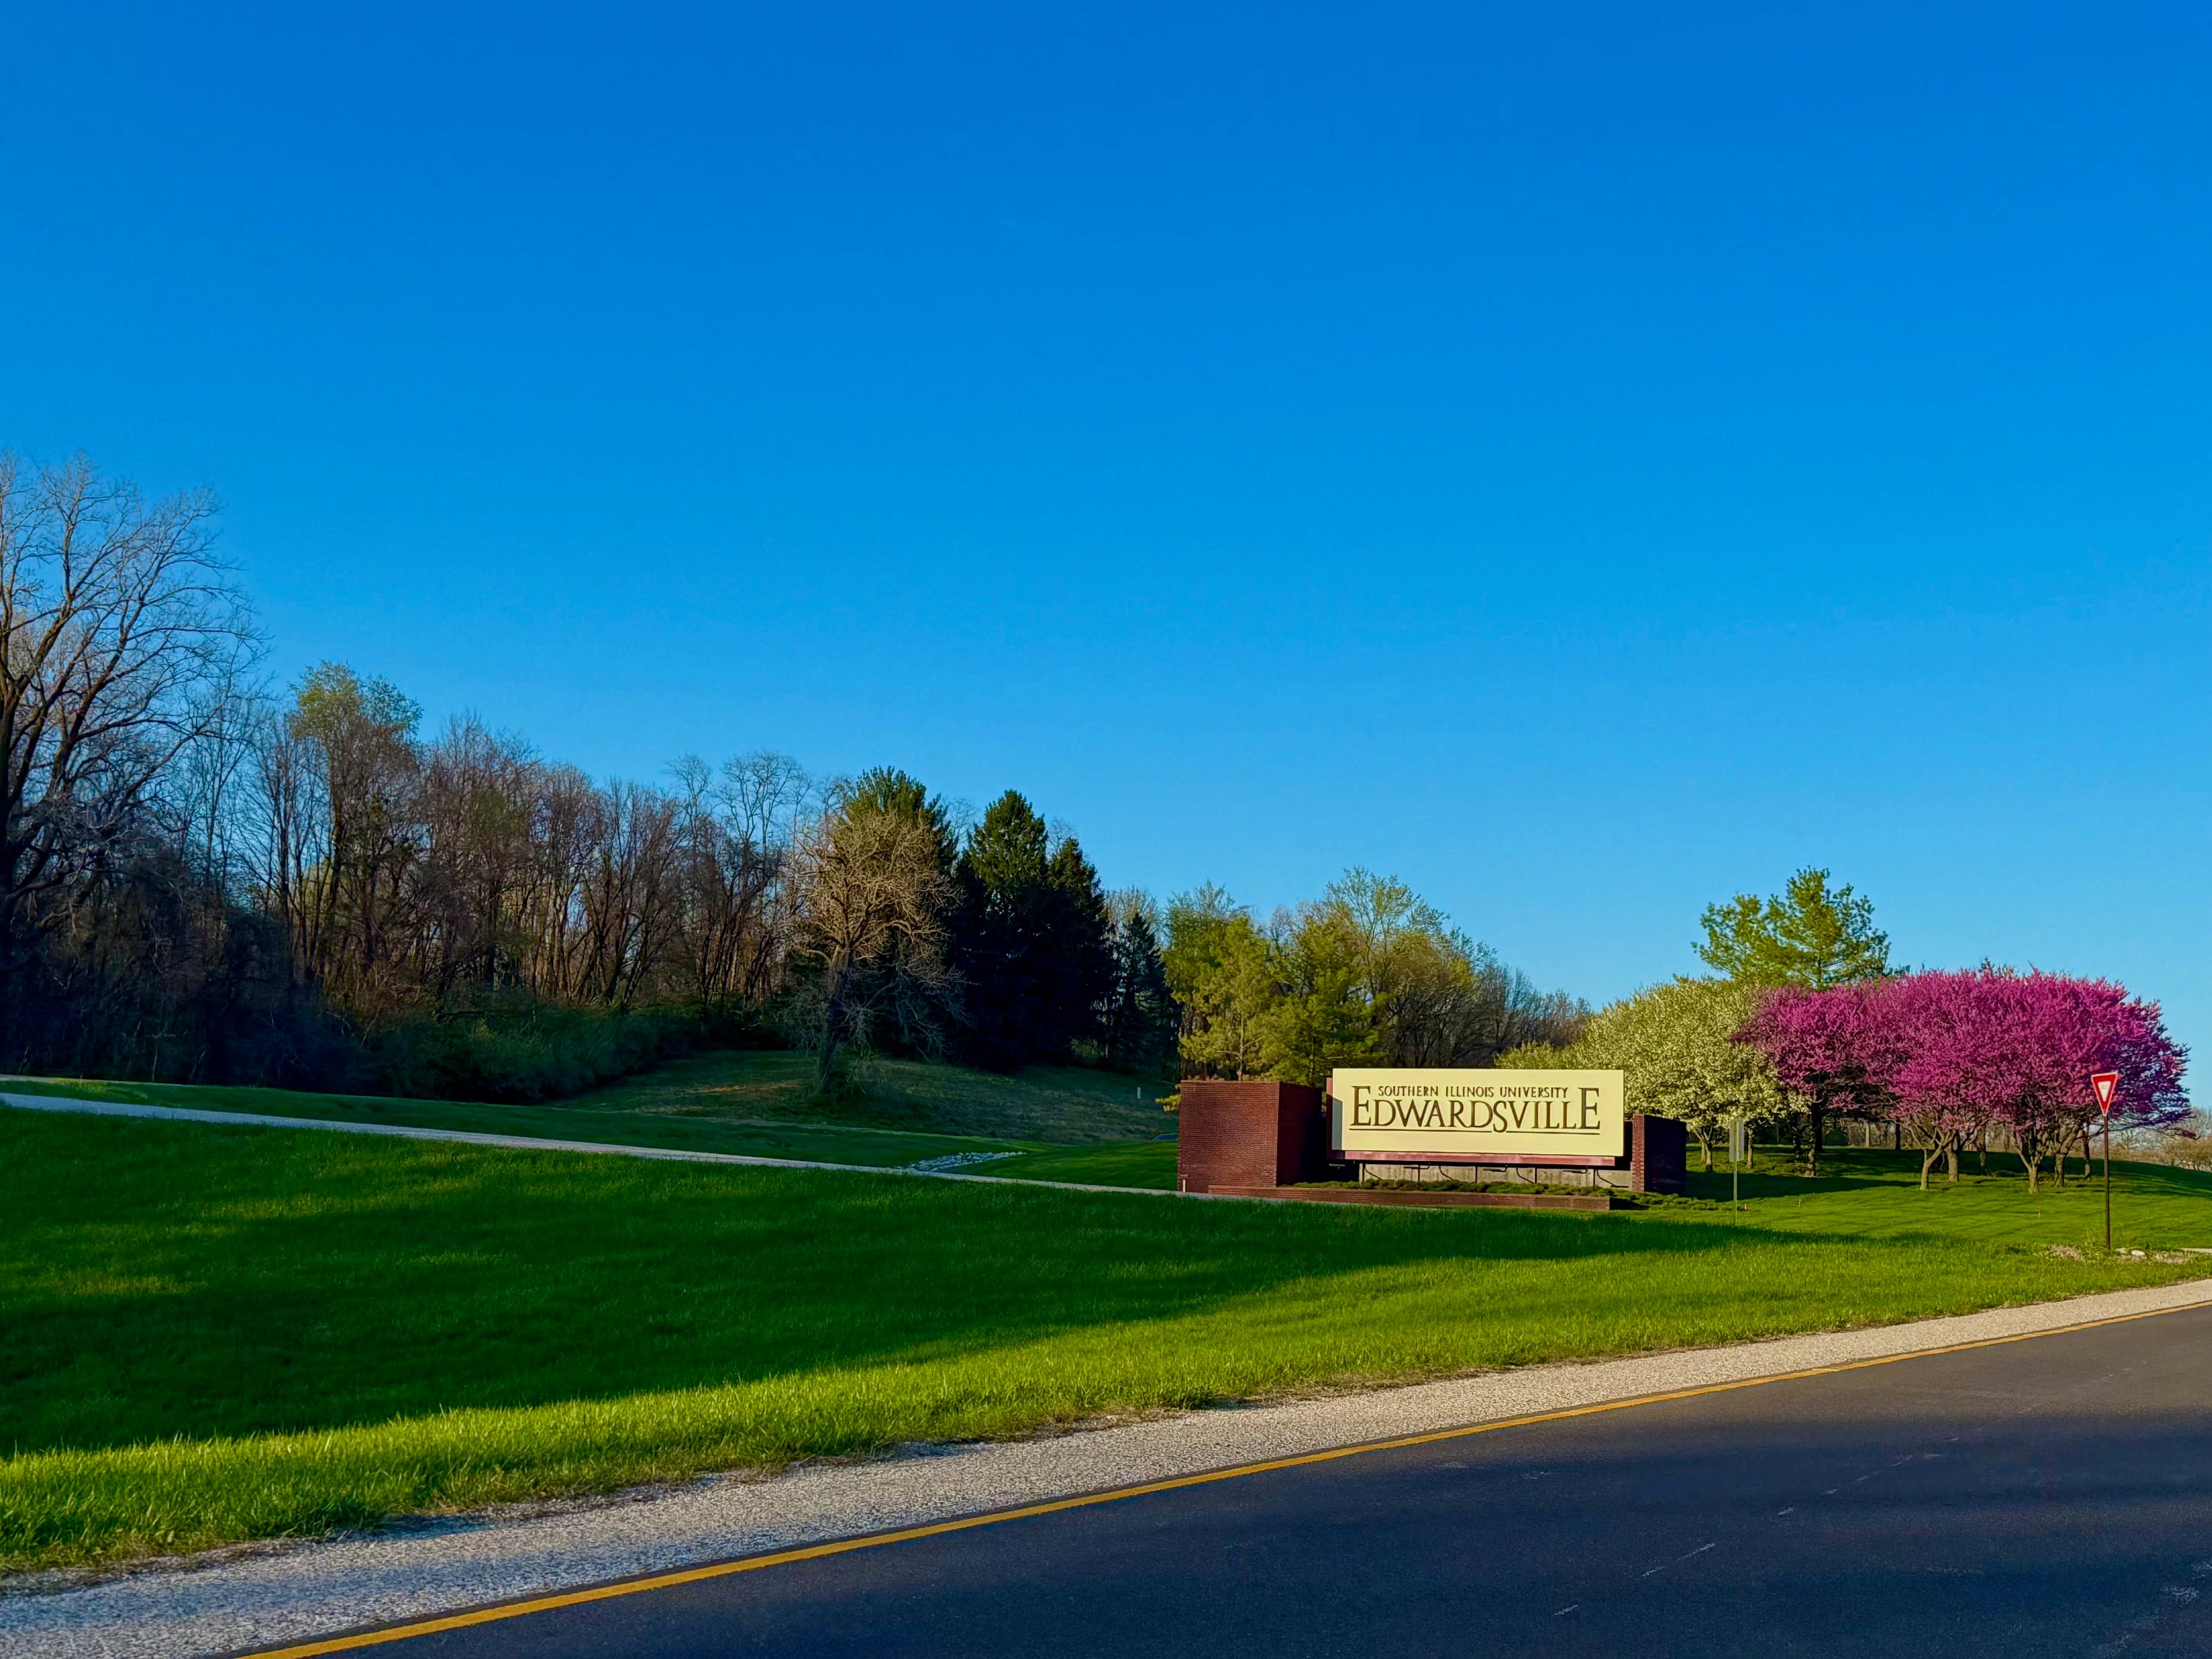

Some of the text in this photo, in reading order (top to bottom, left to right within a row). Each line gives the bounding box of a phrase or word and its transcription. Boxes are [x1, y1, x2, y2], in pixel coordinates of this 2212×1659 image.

[1378, 1085, 1568, 1098] SOUTHERN ILLINOIS UNIVERSITY
[1350, 1085, 1601, 1133] EDWARDSVILLE
